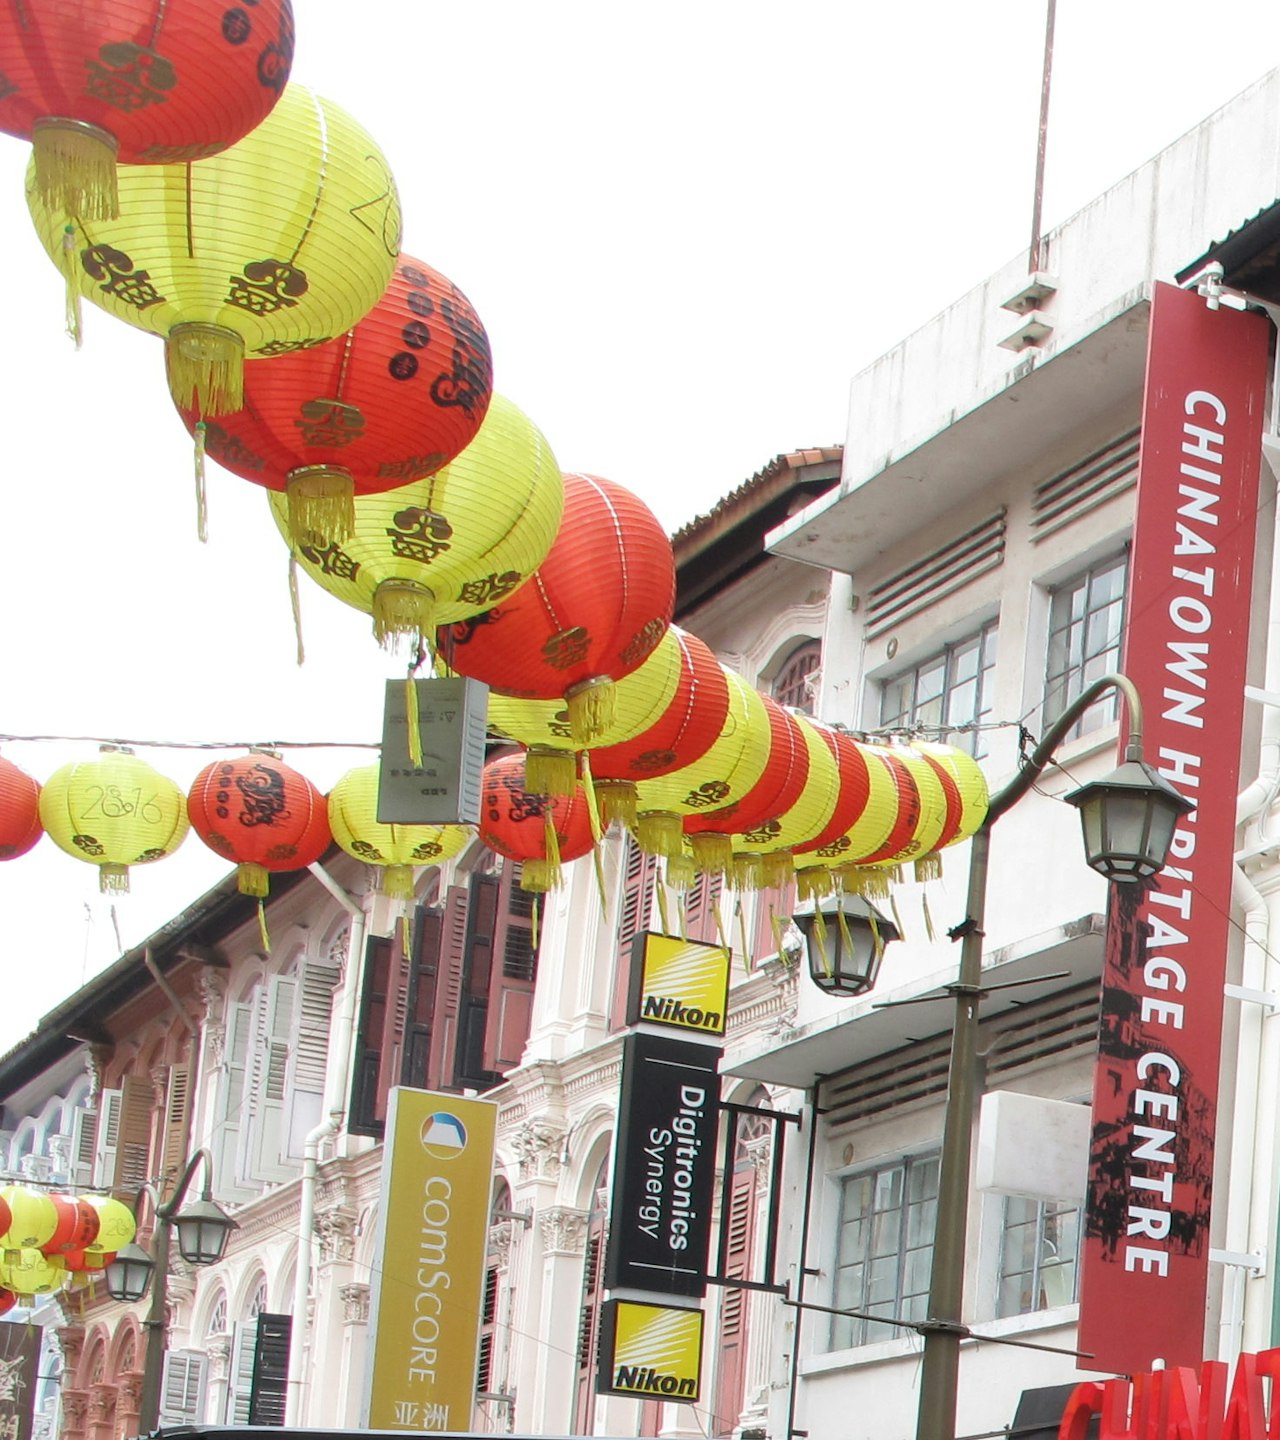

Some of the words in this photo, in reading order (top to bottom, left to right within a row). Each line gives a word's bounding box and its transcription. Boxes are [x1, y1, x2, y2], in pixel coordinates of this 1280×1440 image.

[1159, 389, 1227, 728] CHINATOWN
[1140, 746, 1200, 1030] HRITAGE
[642, 995, 721, 1029] Nikon
[637, 1127, 673, 1240] Synergy
[668, 1085, 706, 1251] Digitronics
[1124, 1051, 1181, 1278] CENTRE
[390, 1399, 450, 1432] 亚洲
[615, 1365, 697, 1397] Nikon
